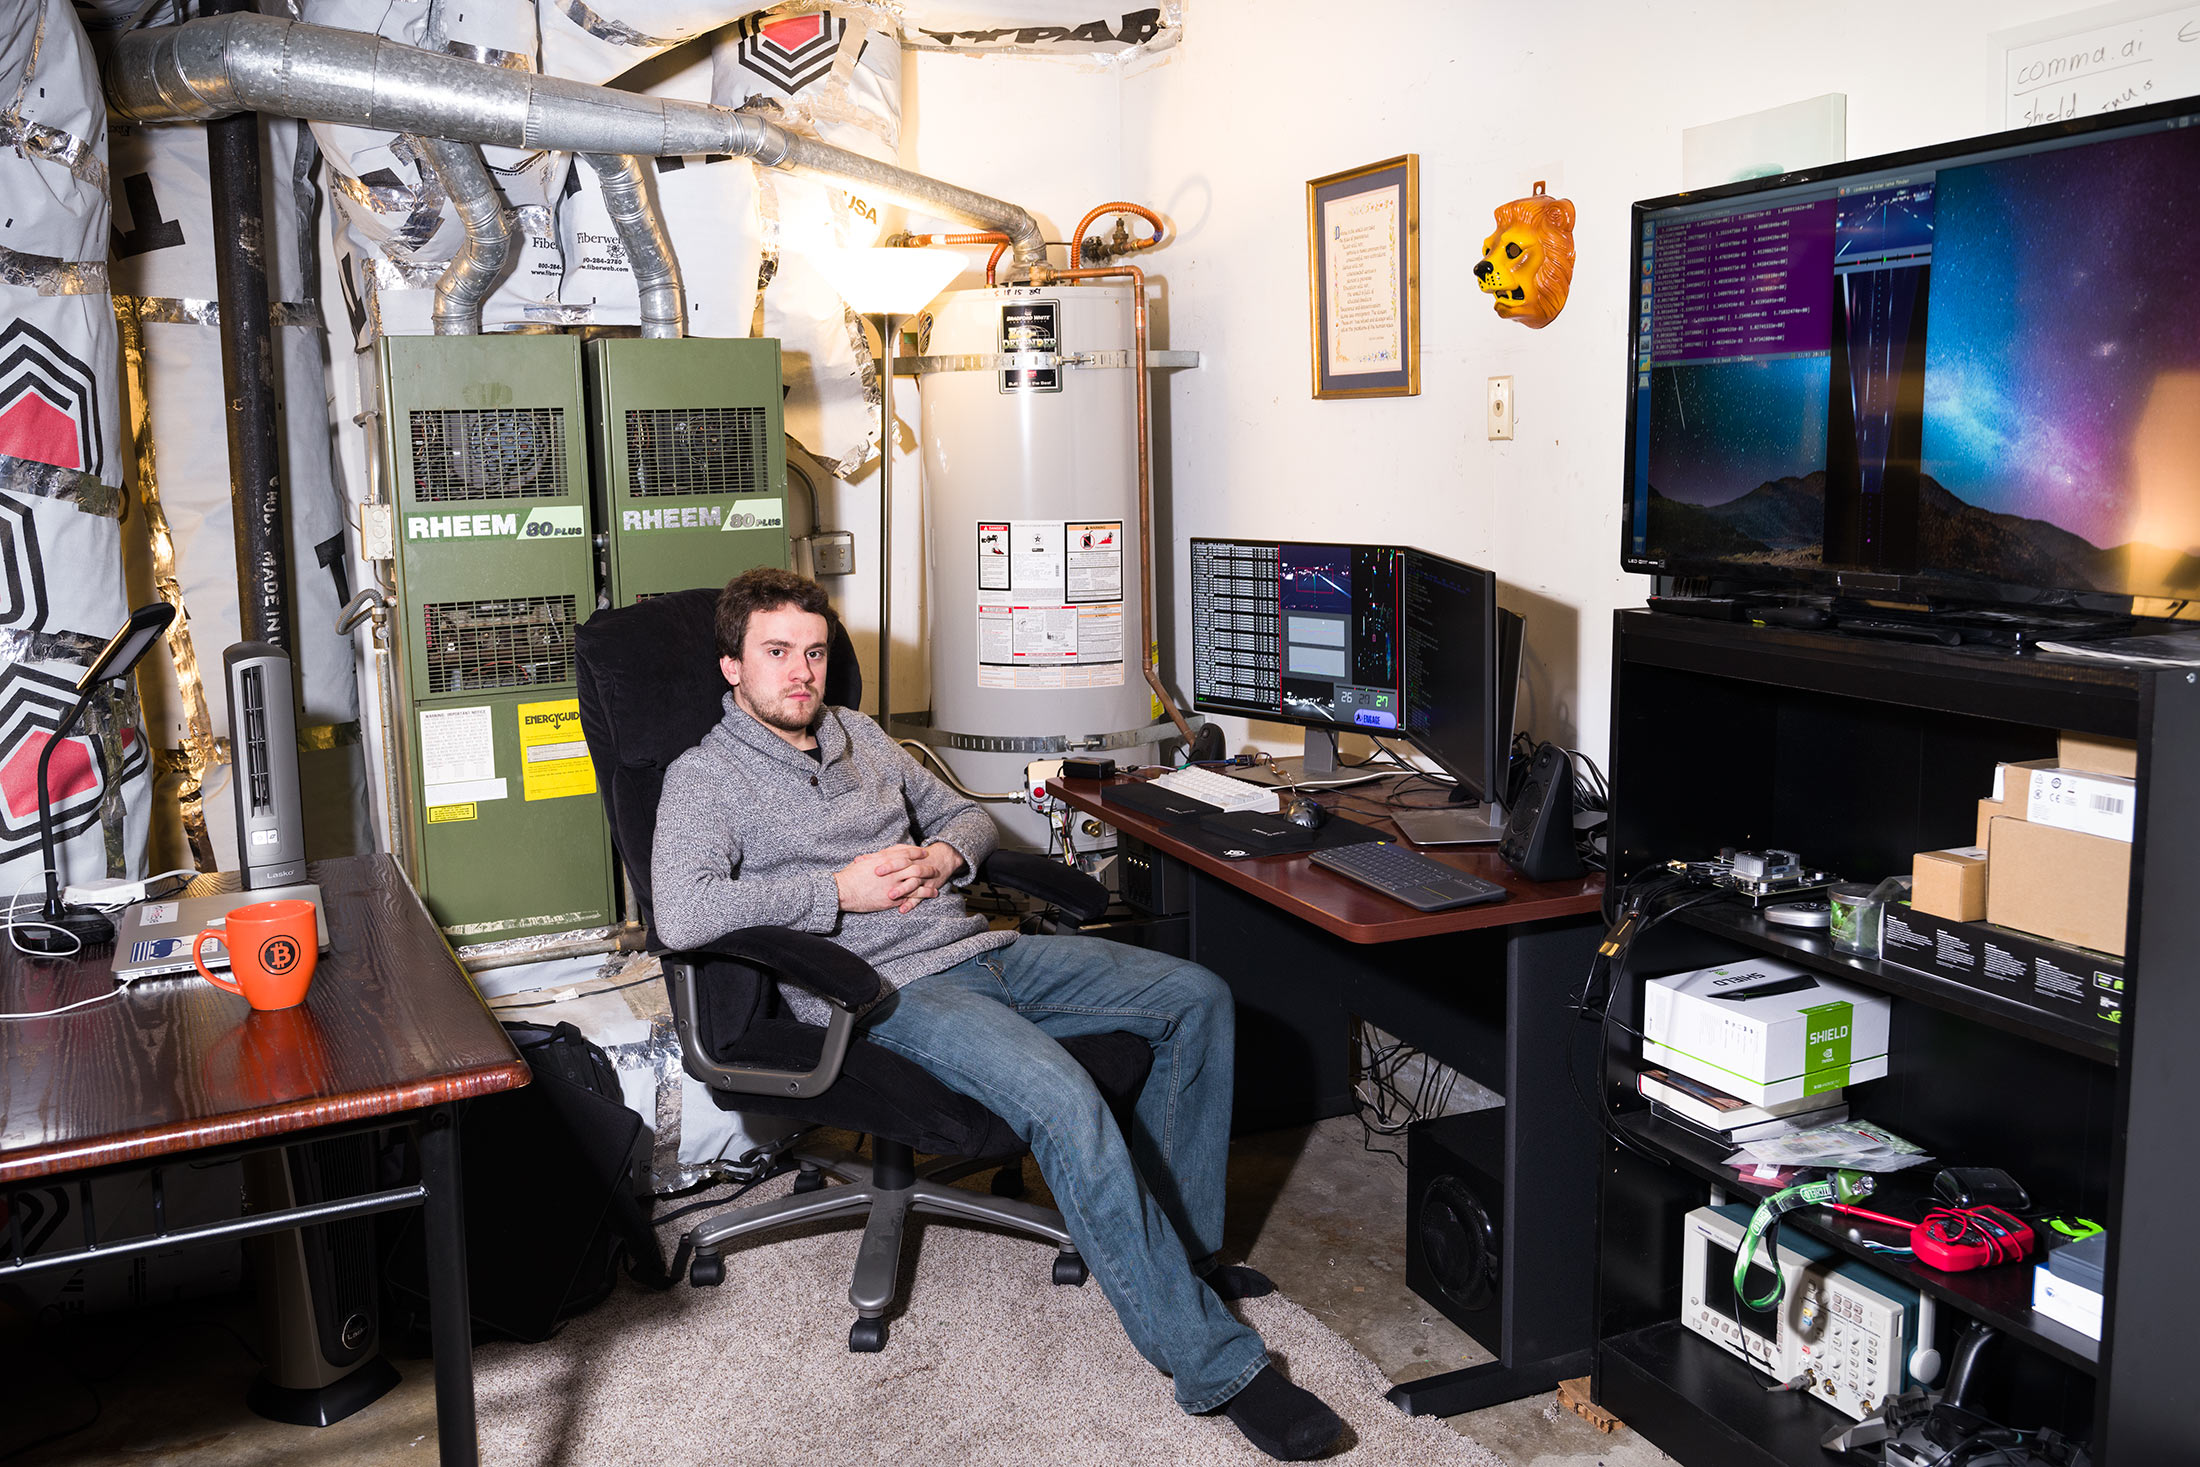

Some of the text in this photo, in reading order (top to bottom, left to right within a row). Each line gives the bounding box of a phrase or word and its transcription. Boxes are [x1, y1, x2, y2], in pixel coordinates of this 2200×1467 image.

[918, 8, 1161, 46] TYPAR
[532, 236, 559, 250] Fibe
[538, 262, 564, 270] 800-284-
[582, 256, 623, 265] 0-284-2780
[579, 264, 629, 273] w.fiberweb.com
[1003, 338, 1057, 349] DEFNDER
[622, 505, 782, 532] RHEEM 80 PLUS
[407, 513, 583, 540] RHEEM 80 PLUS
[262, 551, 279, 606] MADE
[266, 611, 282, 632] IN
[1341, 691, 1353, 704] 26
[525, 711, 581, 728] ENERGYGUID
[1363, 714, 1381, 726] ENGAGE
[266, 869, 294, 880] Lasko
[1713, 972, 1767, 987] SHIELD
[1809, 1025, 1849, 1046] SHIELD
